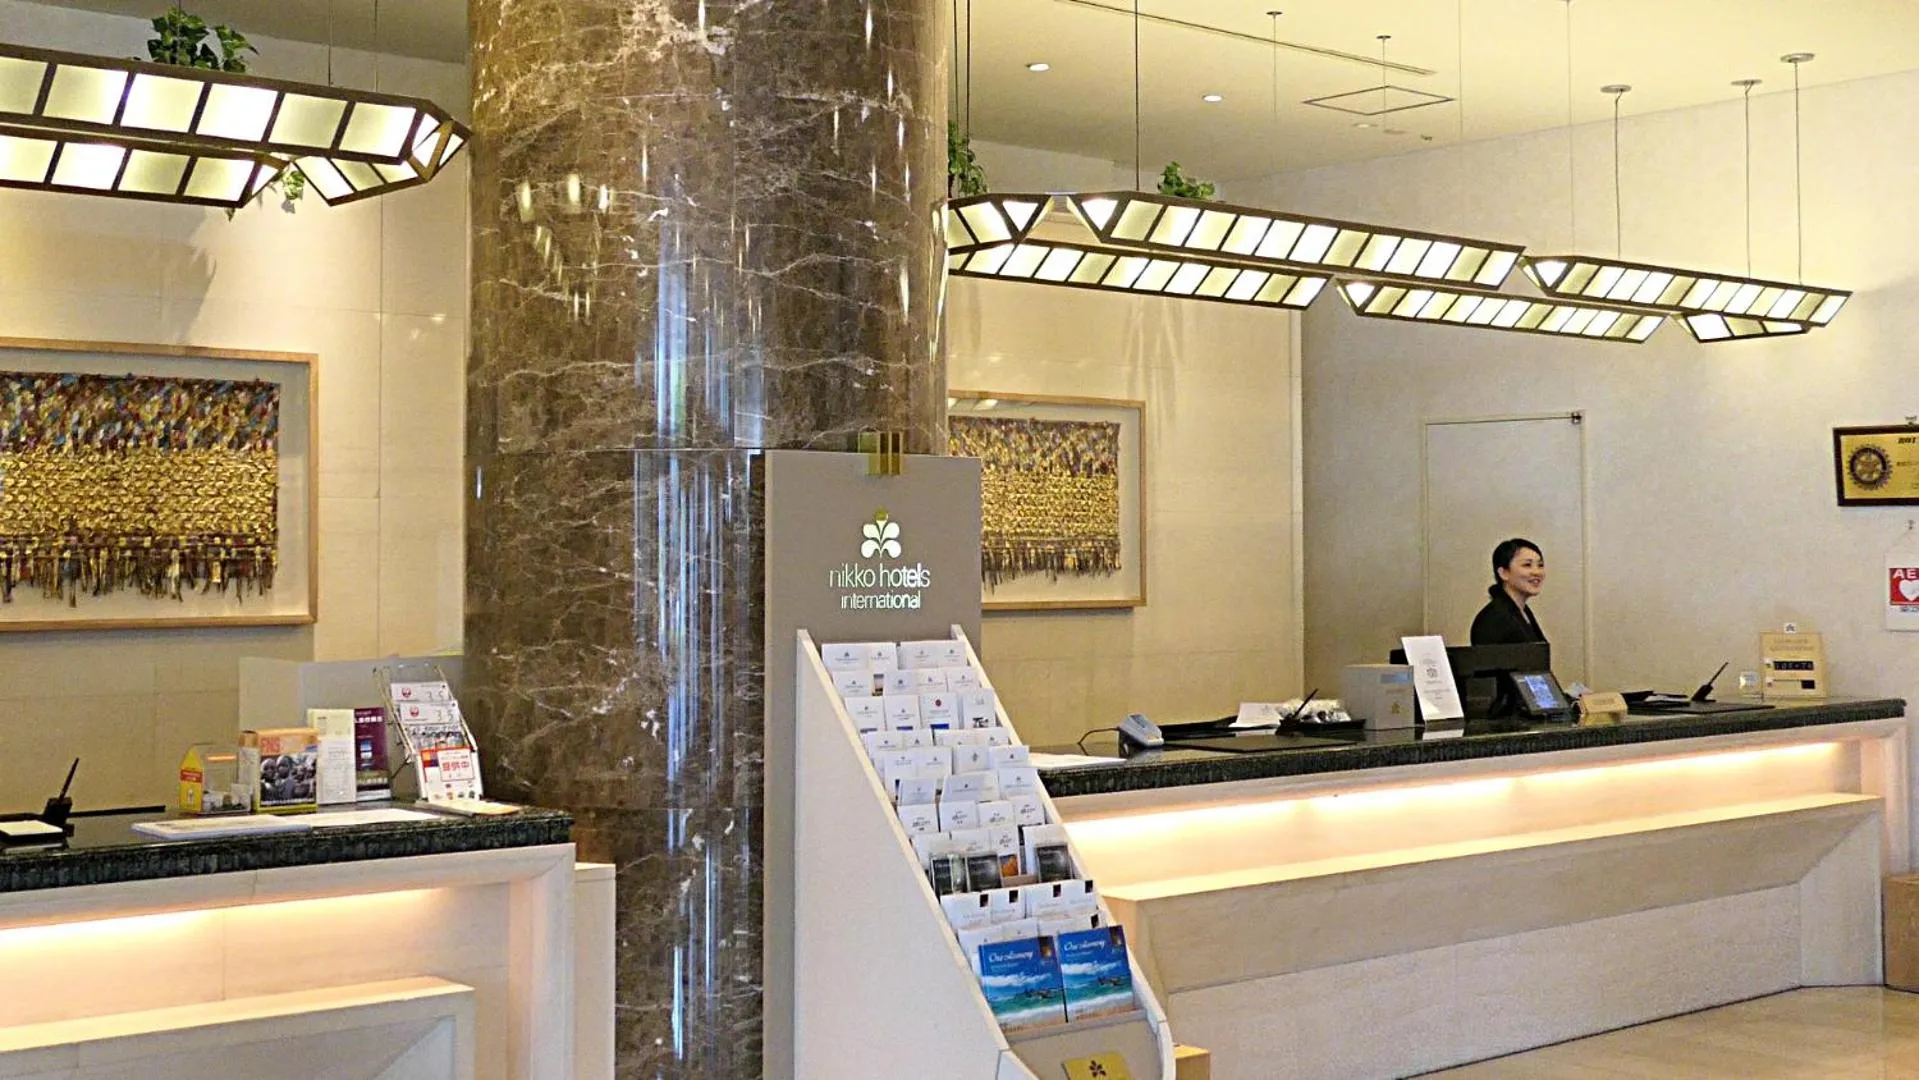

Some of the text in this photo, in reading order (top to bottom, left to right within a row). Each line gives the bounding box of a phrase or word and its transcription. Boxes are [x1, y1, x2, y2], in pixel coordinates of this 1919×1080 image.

[829, 562, 931, 588] nikko hotels
[841, 590, 921, 609] international
